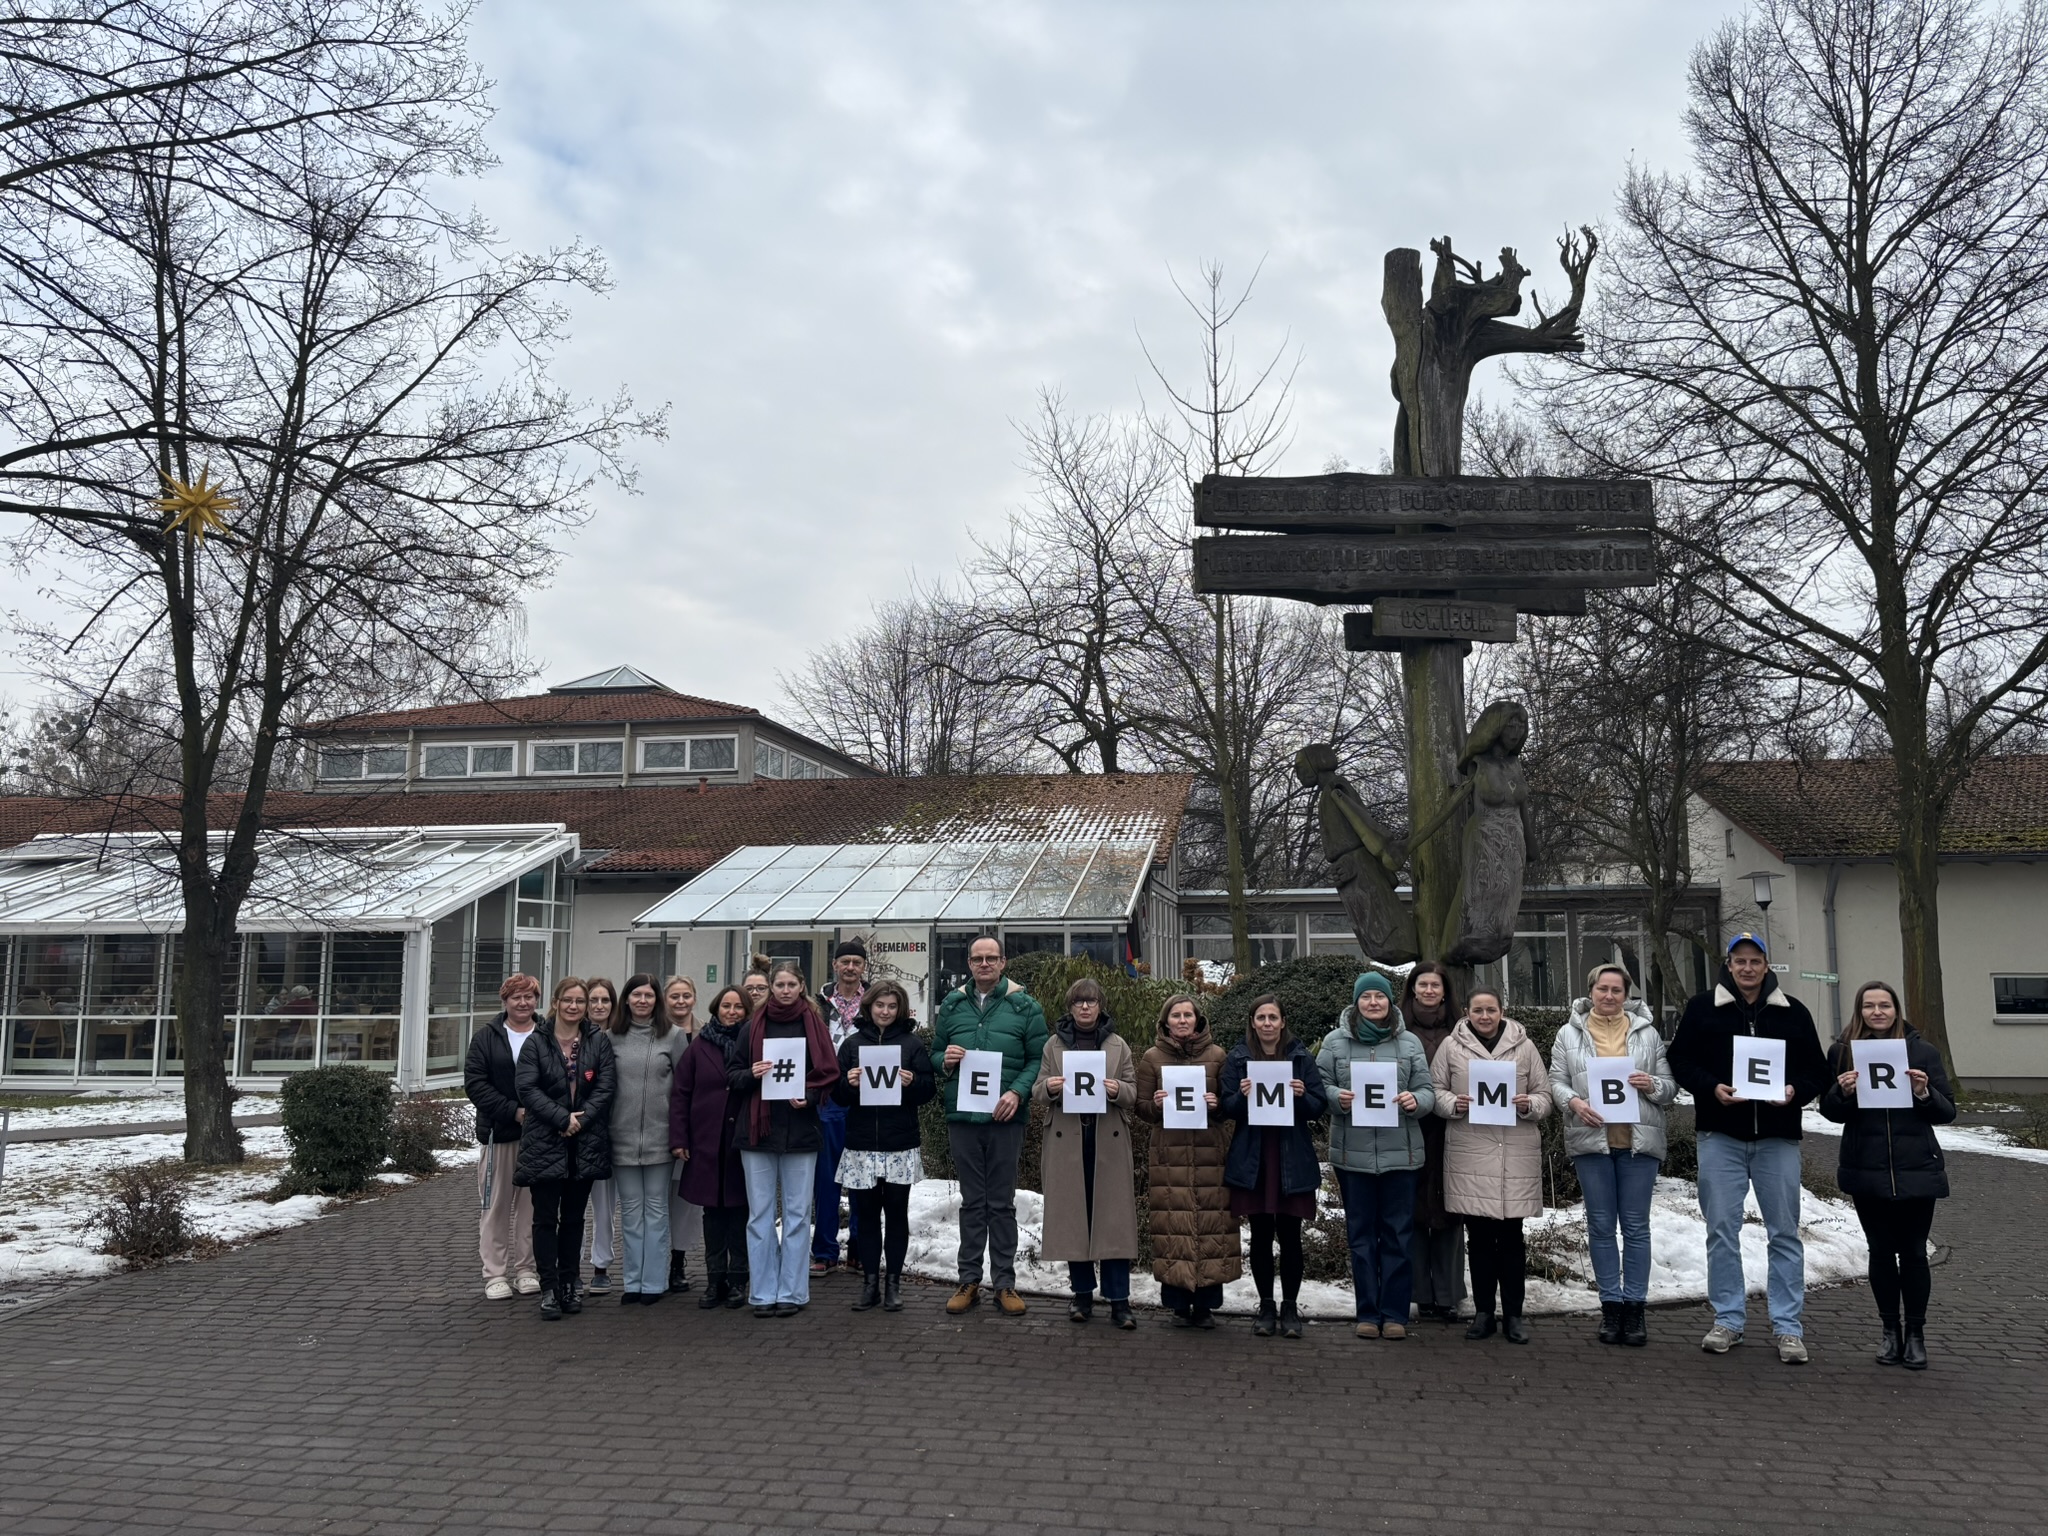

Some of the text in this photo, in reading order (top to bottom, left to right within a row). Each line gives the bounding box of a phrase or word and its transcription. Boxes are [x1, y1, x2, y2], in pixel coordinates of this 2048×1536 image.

[773, 1058, 1897, 1111] # W E R E M E M B E R
